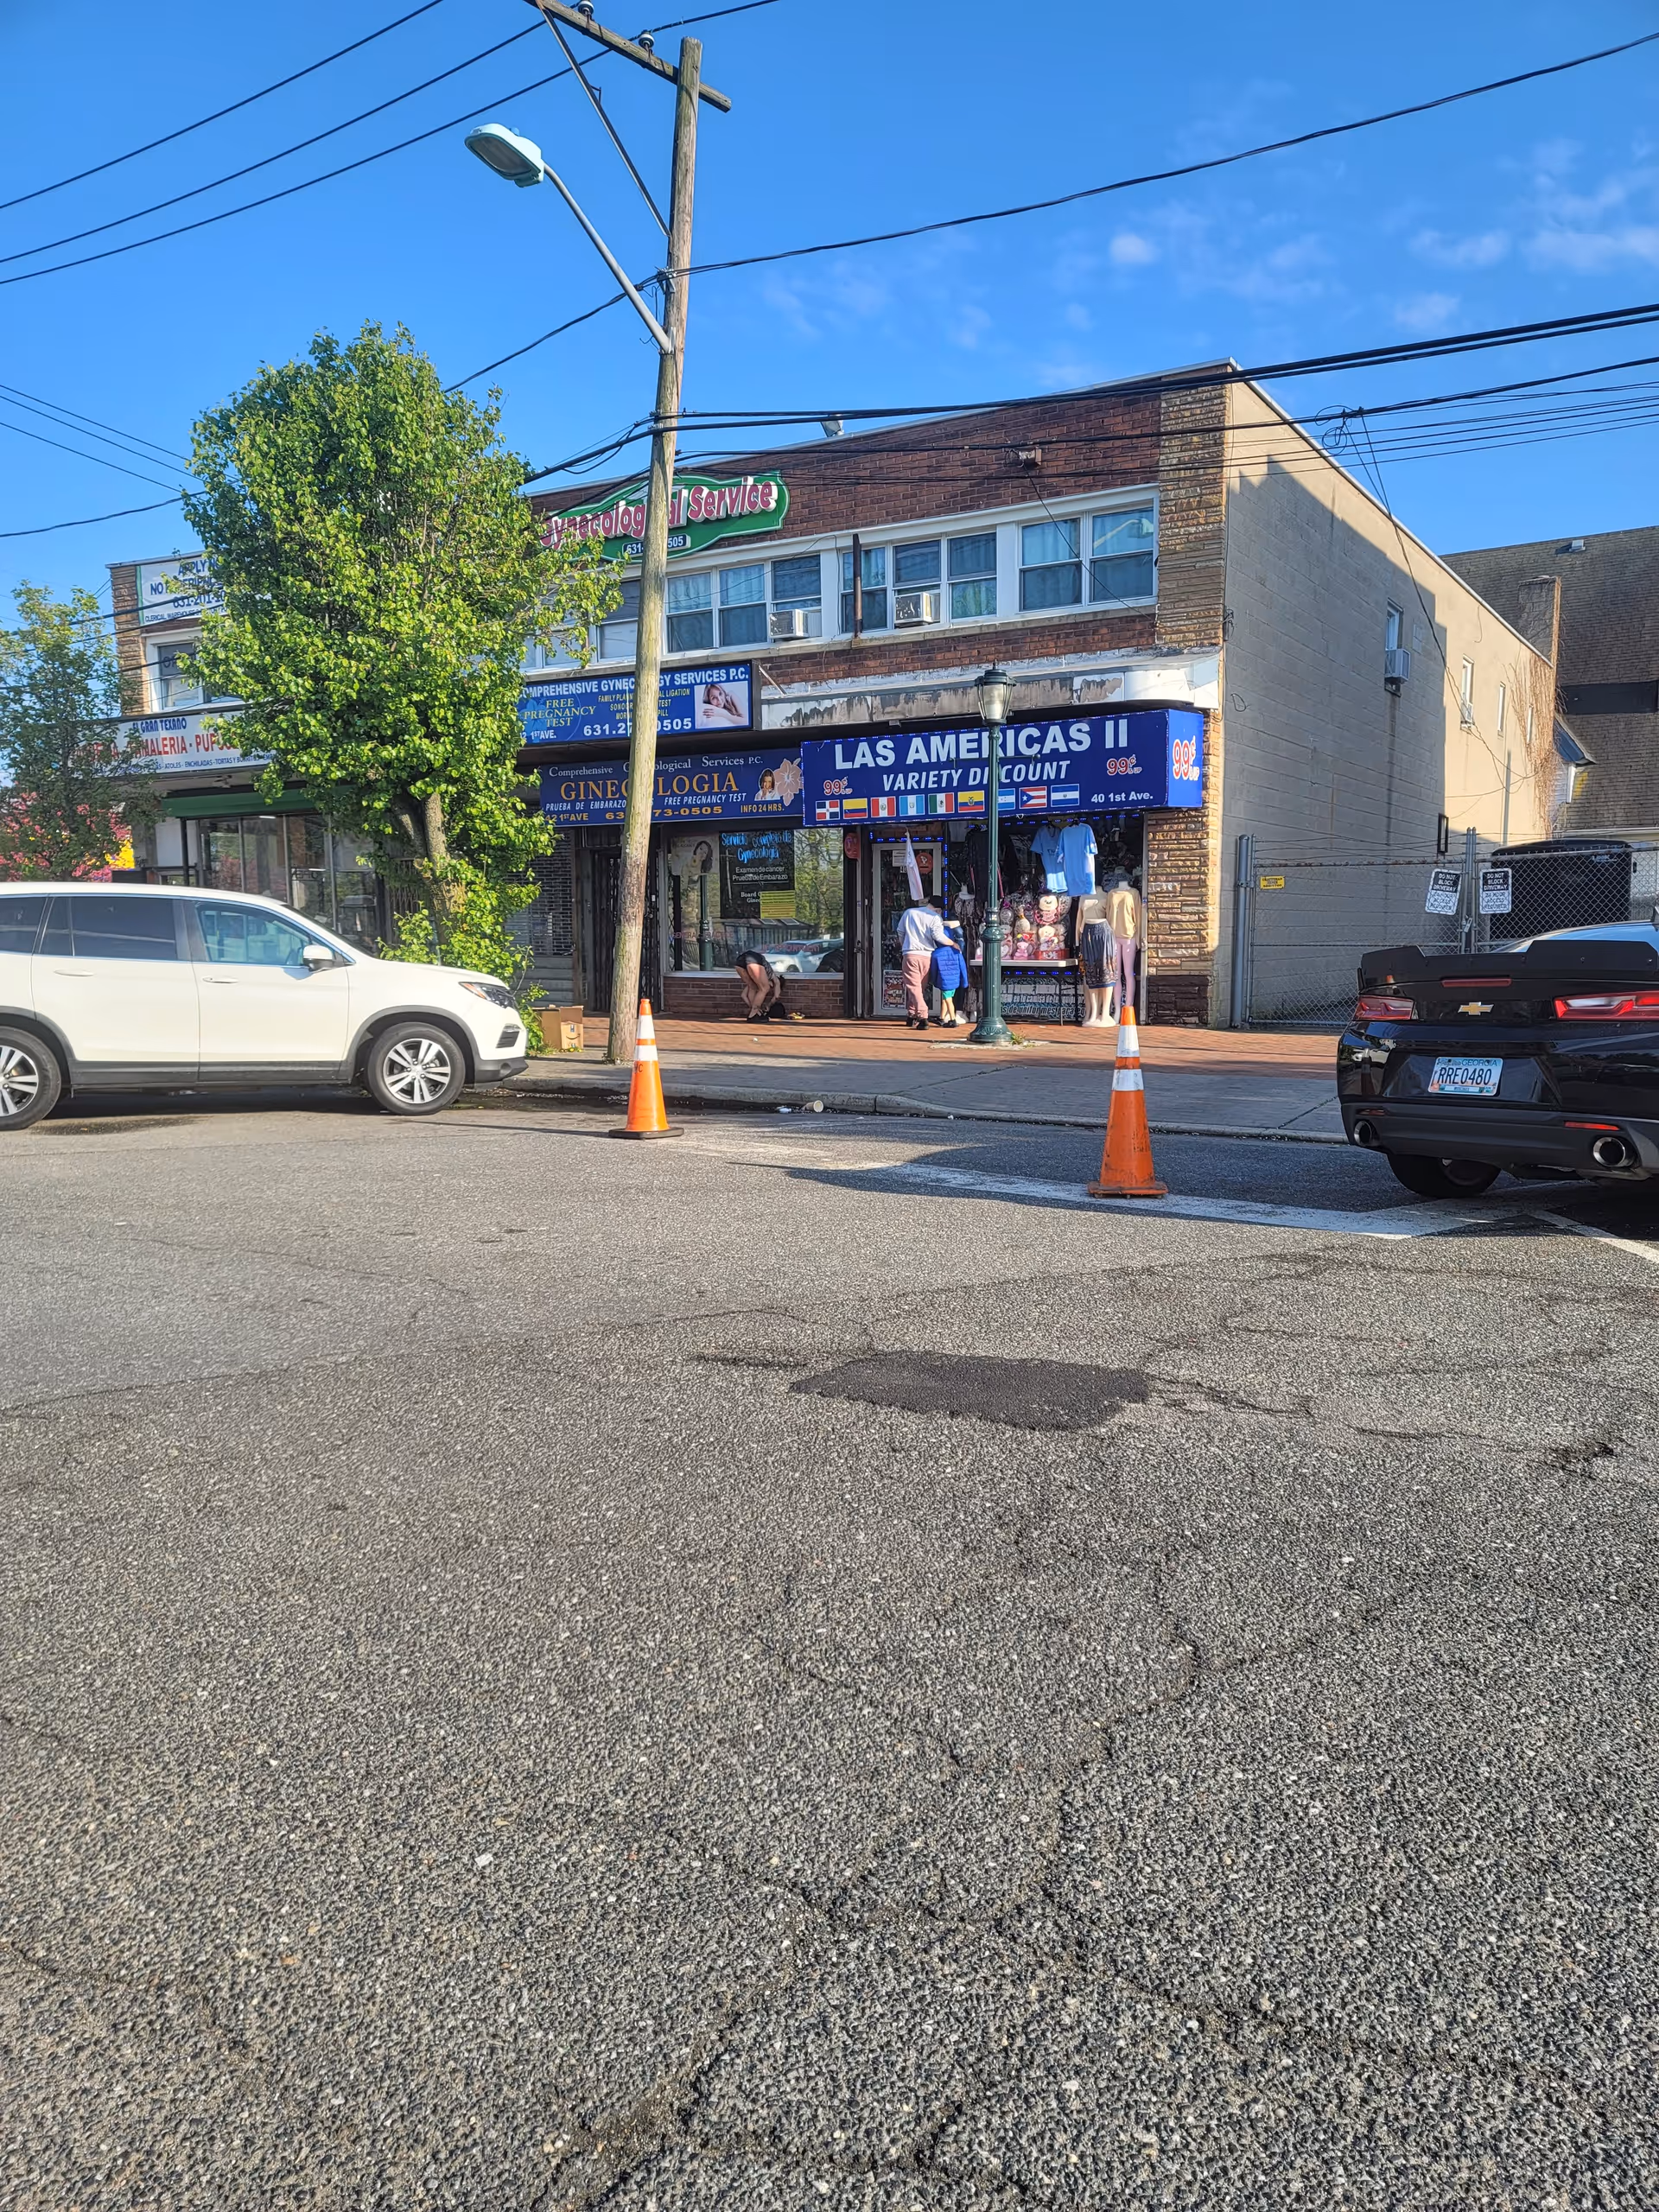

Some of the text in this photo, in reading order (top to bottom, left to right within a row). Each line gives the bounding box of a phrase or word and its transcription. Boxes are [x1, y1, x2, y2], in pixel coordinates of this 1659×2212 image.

[688, 475, 775, 520] Service
[150, 582, 163, 595] NO
[601, 671, 671, 691] GYNECGY
[674, 669, 727, 685] SERVICES
[729, 667, 749, 680] P.C.
[598, 694, 616, 702] FAMILY
[665, 688, 690, 697] LIGATION
[546, 698, 575, 709] FREE
[658, 698, 671, 708] TEST
[524, 706, 596, 720] PREGNANCY
[546, 717, 573, 728] TEST
[835, 719, 1128, 770] LAS AMERICAS II
[185, 757, 213, 768] ENCHILADAS
[215, 757, 232, 766] TORTAS
[549, 766, 613, 779] Comprehensive
[702, 755, 744, 767] Services
[882, 760, 1071, 791] VARIETY DICOUNT
[664, 797, 681, 806] FREE
[683, 794, 726, 804] PREGNANCY
[728, 792, 747, 803] TEST
[1091, 791, 1154, 804] 40 1st Ave.
[546, 799, 626, 811] PRUEBA DE EMBARAZO
[741, 803, 785, 814] INFO 24 HRS.
[722, 832, 748, 846] Servicio
[1437, 1066, 1492, 1086] RRE0480
